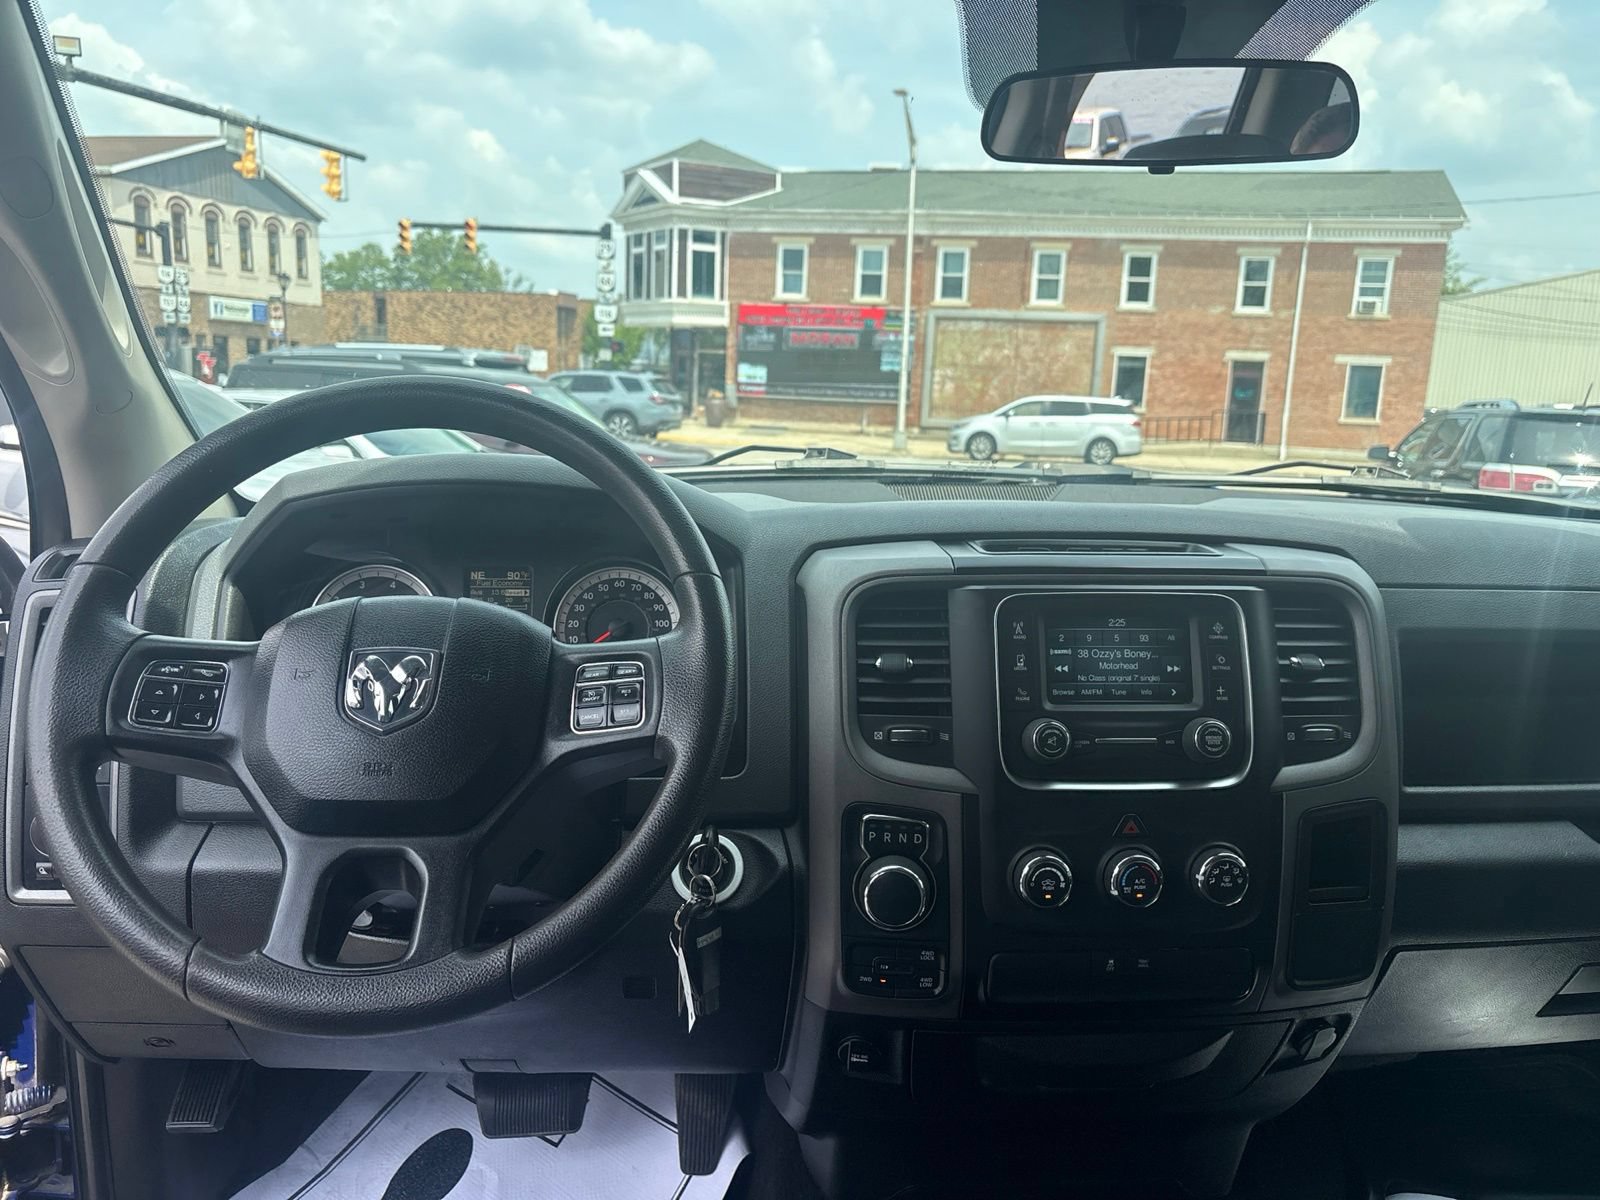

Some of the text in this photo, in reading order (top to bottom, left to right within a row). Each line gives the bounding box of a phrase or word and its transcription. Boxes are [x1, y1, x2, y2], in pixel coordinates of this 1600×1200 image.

[470, 571, 485, 580] NE
[359, 581, 365, 589] 3
[390, 581, 396, 589] 4
[598, 584, 609, 592] 50
[614, 580, 625, 588] 60
[583, 592, 593, 600] 40
[644, 592, 655, 600] 80
[574, 604, 585, 612] 30
[653, 604, 664, 612] 90
[568, 620, 579, 628] 20
[1108, 618, 1126, 627] 2:25
[1058, 634, 1065, 642] 2
[1086, 634, 1092, 642] 9
[1114, 634, 1120, 642] 5
[1139, 634, 1149, 642] 93
[1077, 649, 1089, 658] 38
[1091, 649, 1122, 660] Ozzy's
[1099, 662, 1139, 670] Motorhead
[1052, 688, 1153, 696] Browse AM/FM Tune Info
[869, 832, 922, 844] P R N D
